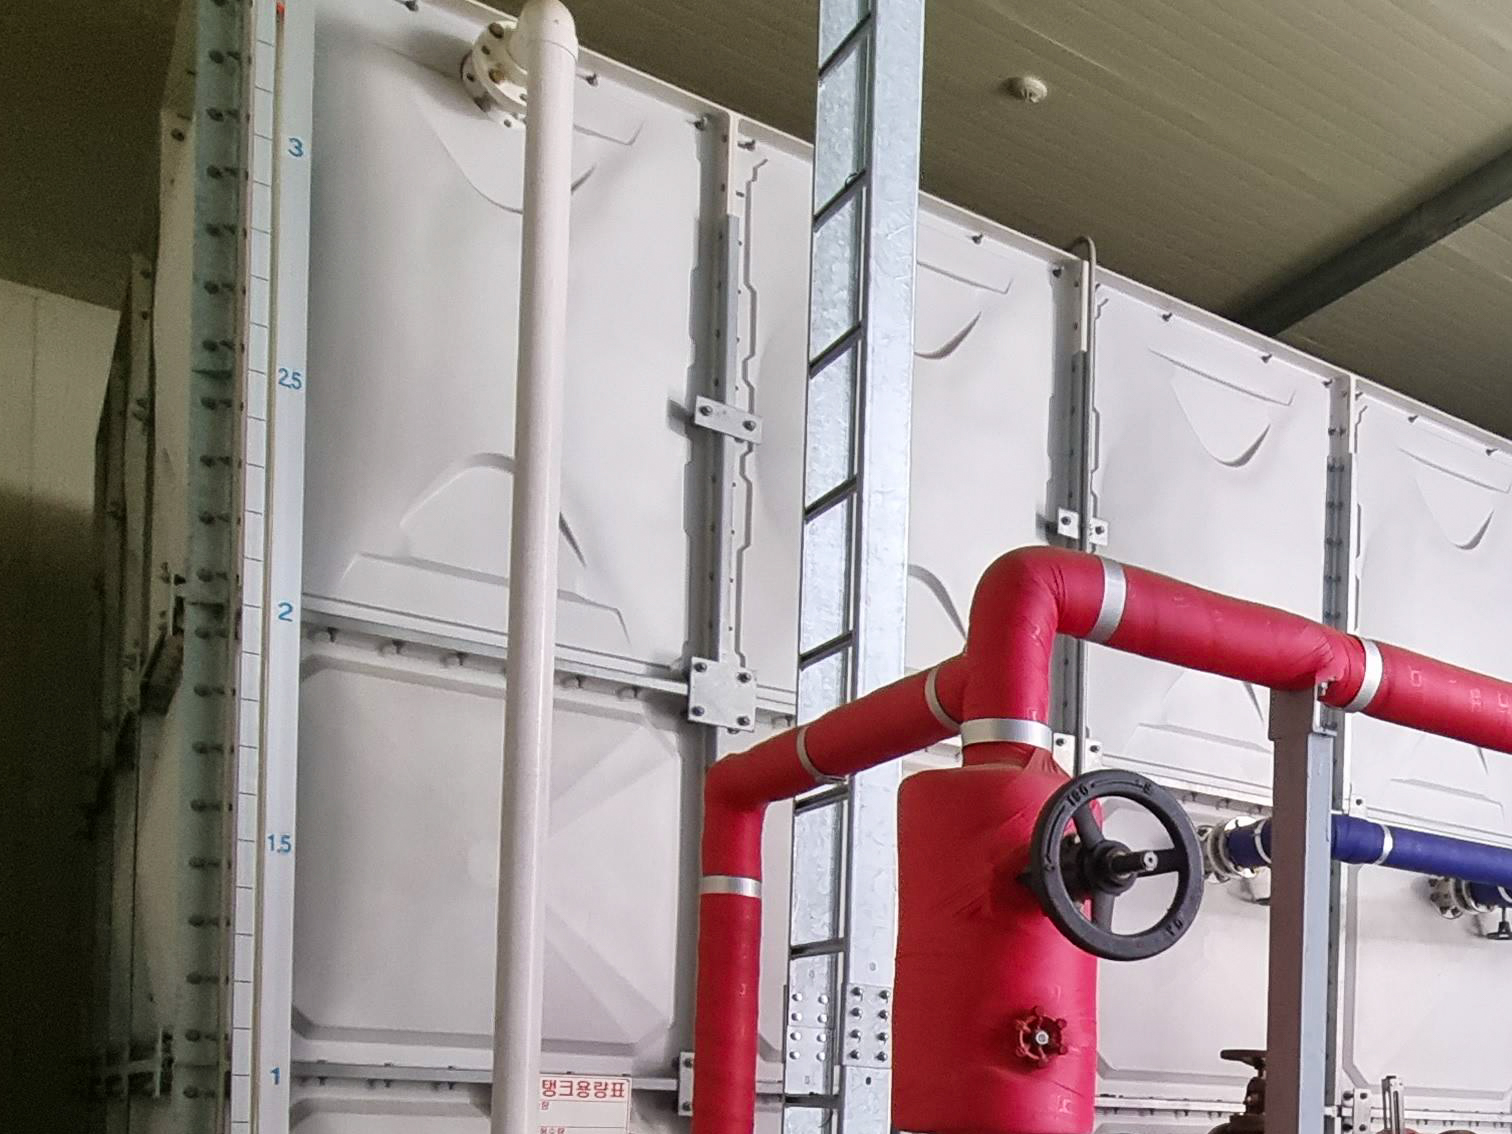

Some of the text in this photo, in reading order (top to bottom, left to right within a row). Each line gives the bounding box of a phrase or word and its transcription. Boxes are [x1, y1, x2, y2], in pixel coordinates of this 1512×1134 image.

[288, 137, 304, 157] 3
[278, 602, 293, 622] 2
[267, 833, 292, 853] 1.5
[270, 1067, 280, 1085] 1
[541, 1079, 625, 1099] 탱크용량표
